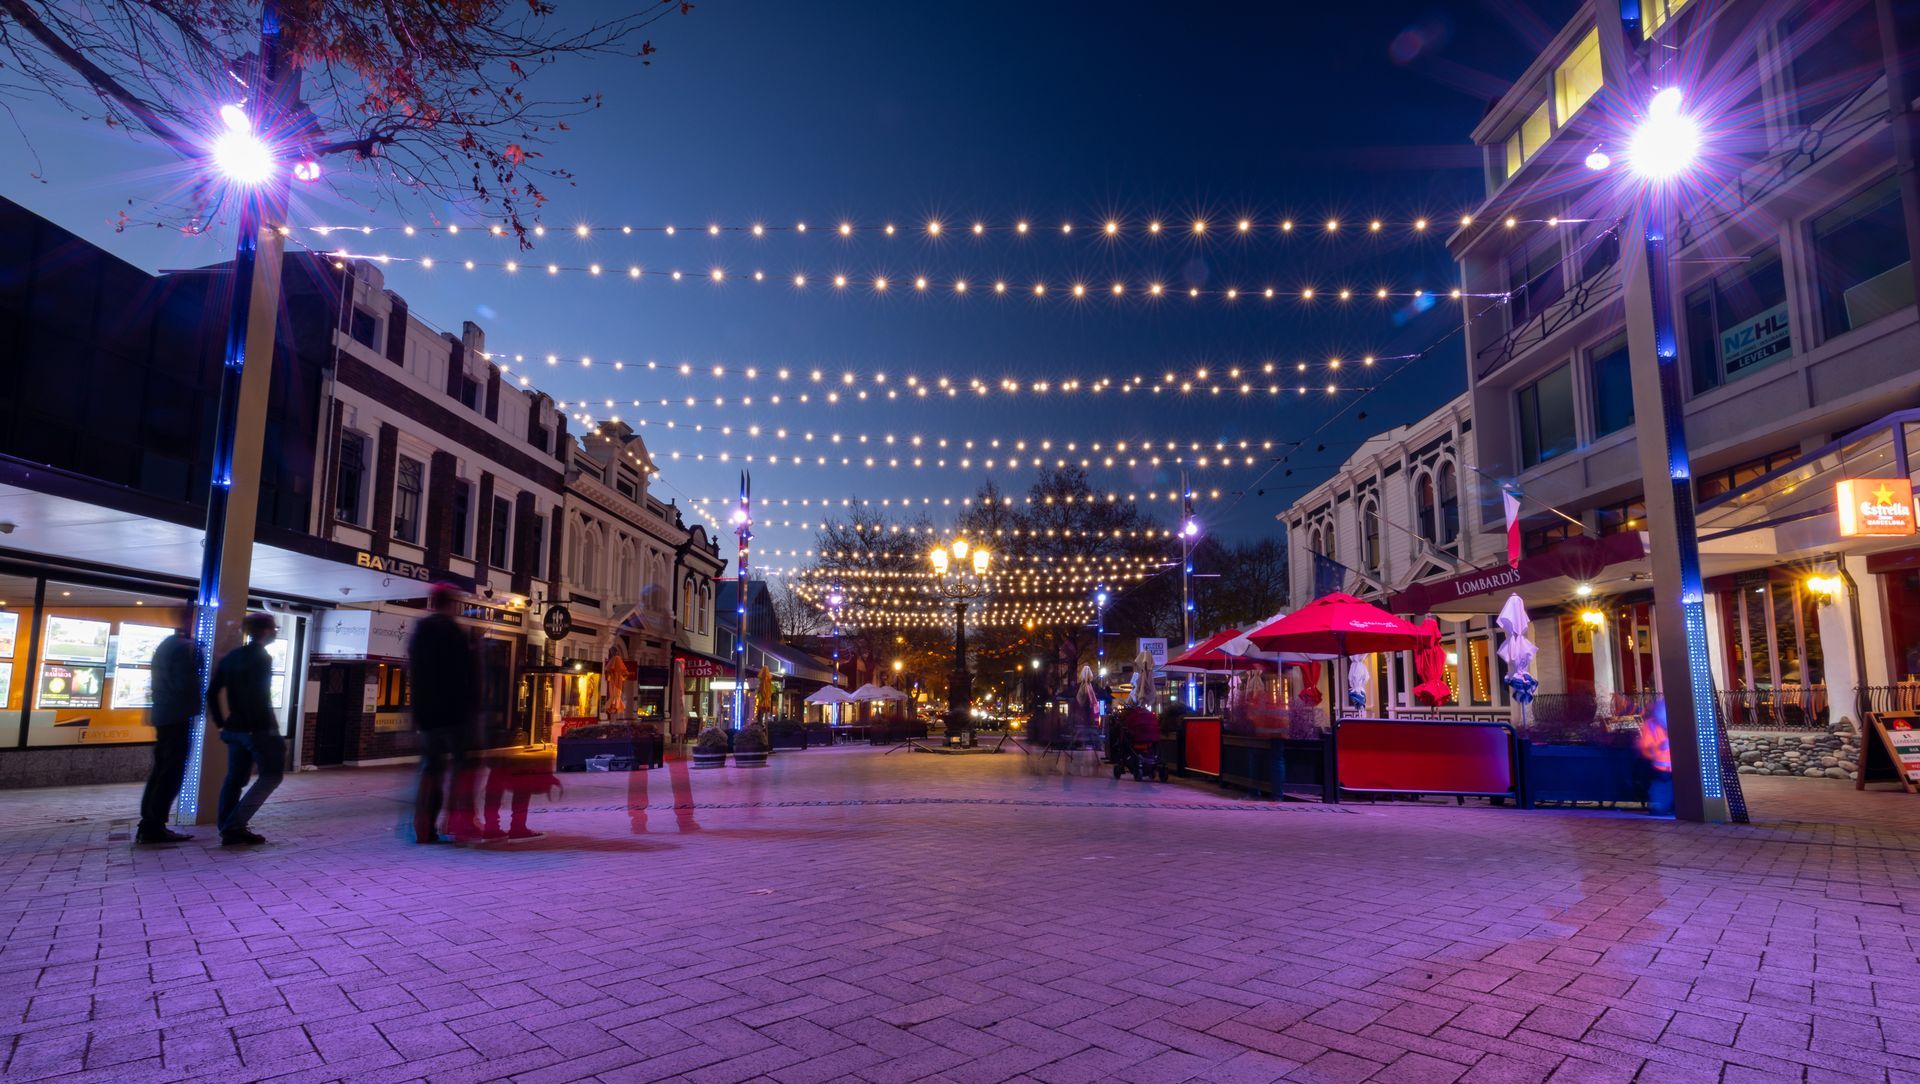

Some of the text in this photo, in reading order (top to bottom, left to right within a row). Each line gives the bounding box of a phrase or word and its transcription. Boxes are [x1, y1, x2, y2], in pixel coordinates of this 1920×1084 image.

[1723, 315, 1789, 355] NZHL
[1739, 343, 1777, 367] LEVEL 1
[1860, 501, 1911, 516] Estrella
[357, 551, 430, 581] BAYLEYS
[1455, 568, 1521, 596] LOMBARDI'S
